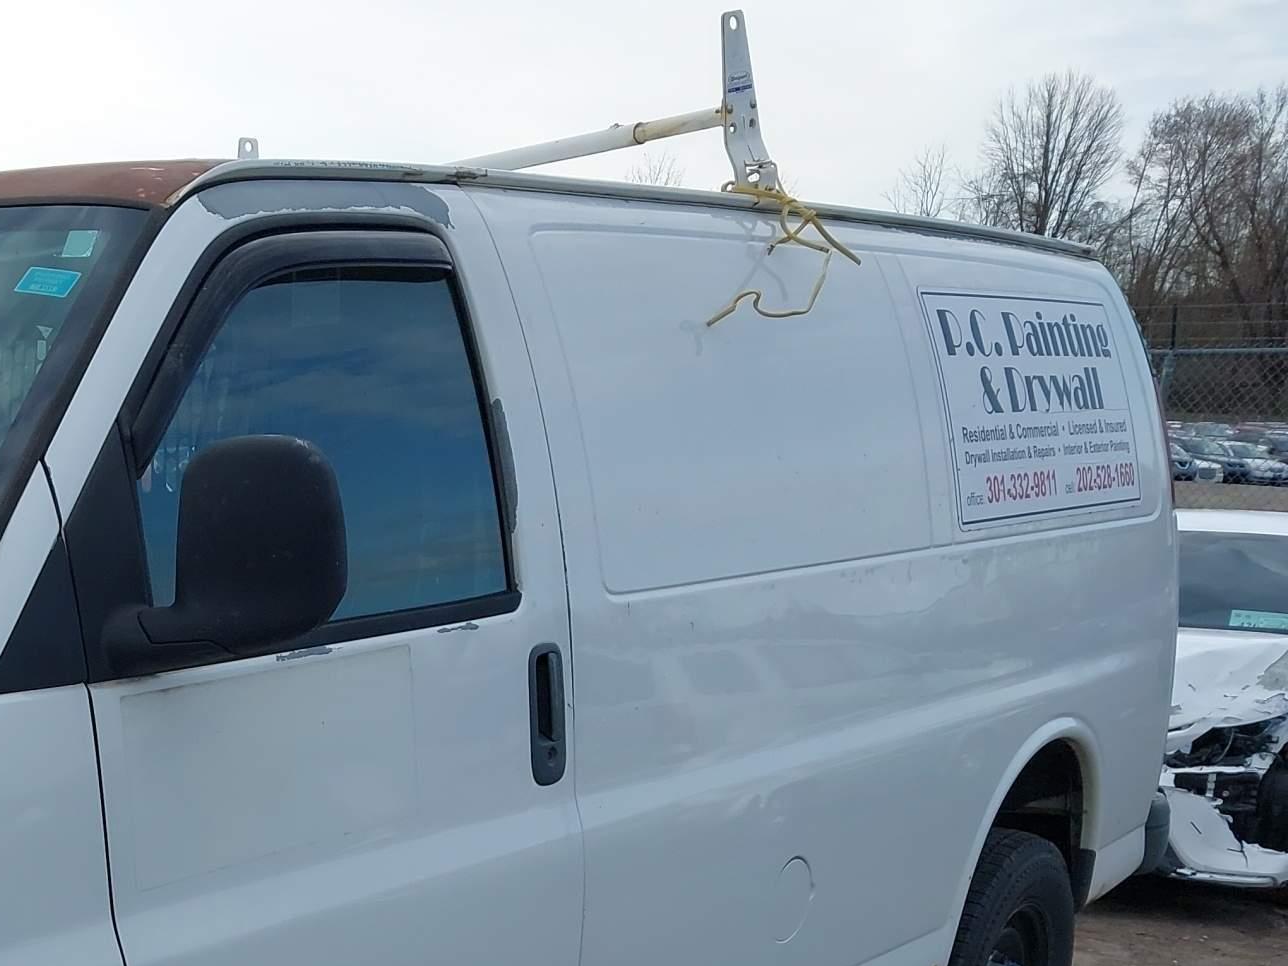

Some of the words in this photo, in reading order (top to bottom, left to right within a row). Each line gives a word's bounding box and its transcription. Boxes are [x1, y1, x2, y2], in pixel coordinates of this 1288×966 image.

[936, 309, 1003, 357] P.C.
[1000, 311, 1112, 359] Painting
[980, 366, 1004, 414] &
[1003, 366, 1105, 413] Drywall
[962, 424, 1007, 443] Residential
[1008, 423, 1015, 440] &
[1016, 421, 1059, 440] Commercial
[1068, 420, 1097, 436] Licensed
[1104, 419, 1127, 433] Insured
[964, 449, 991, 467] Drywall
[990, 447, 1027, 462] Installation
[1032, 444, 1056, 460] Repairs
